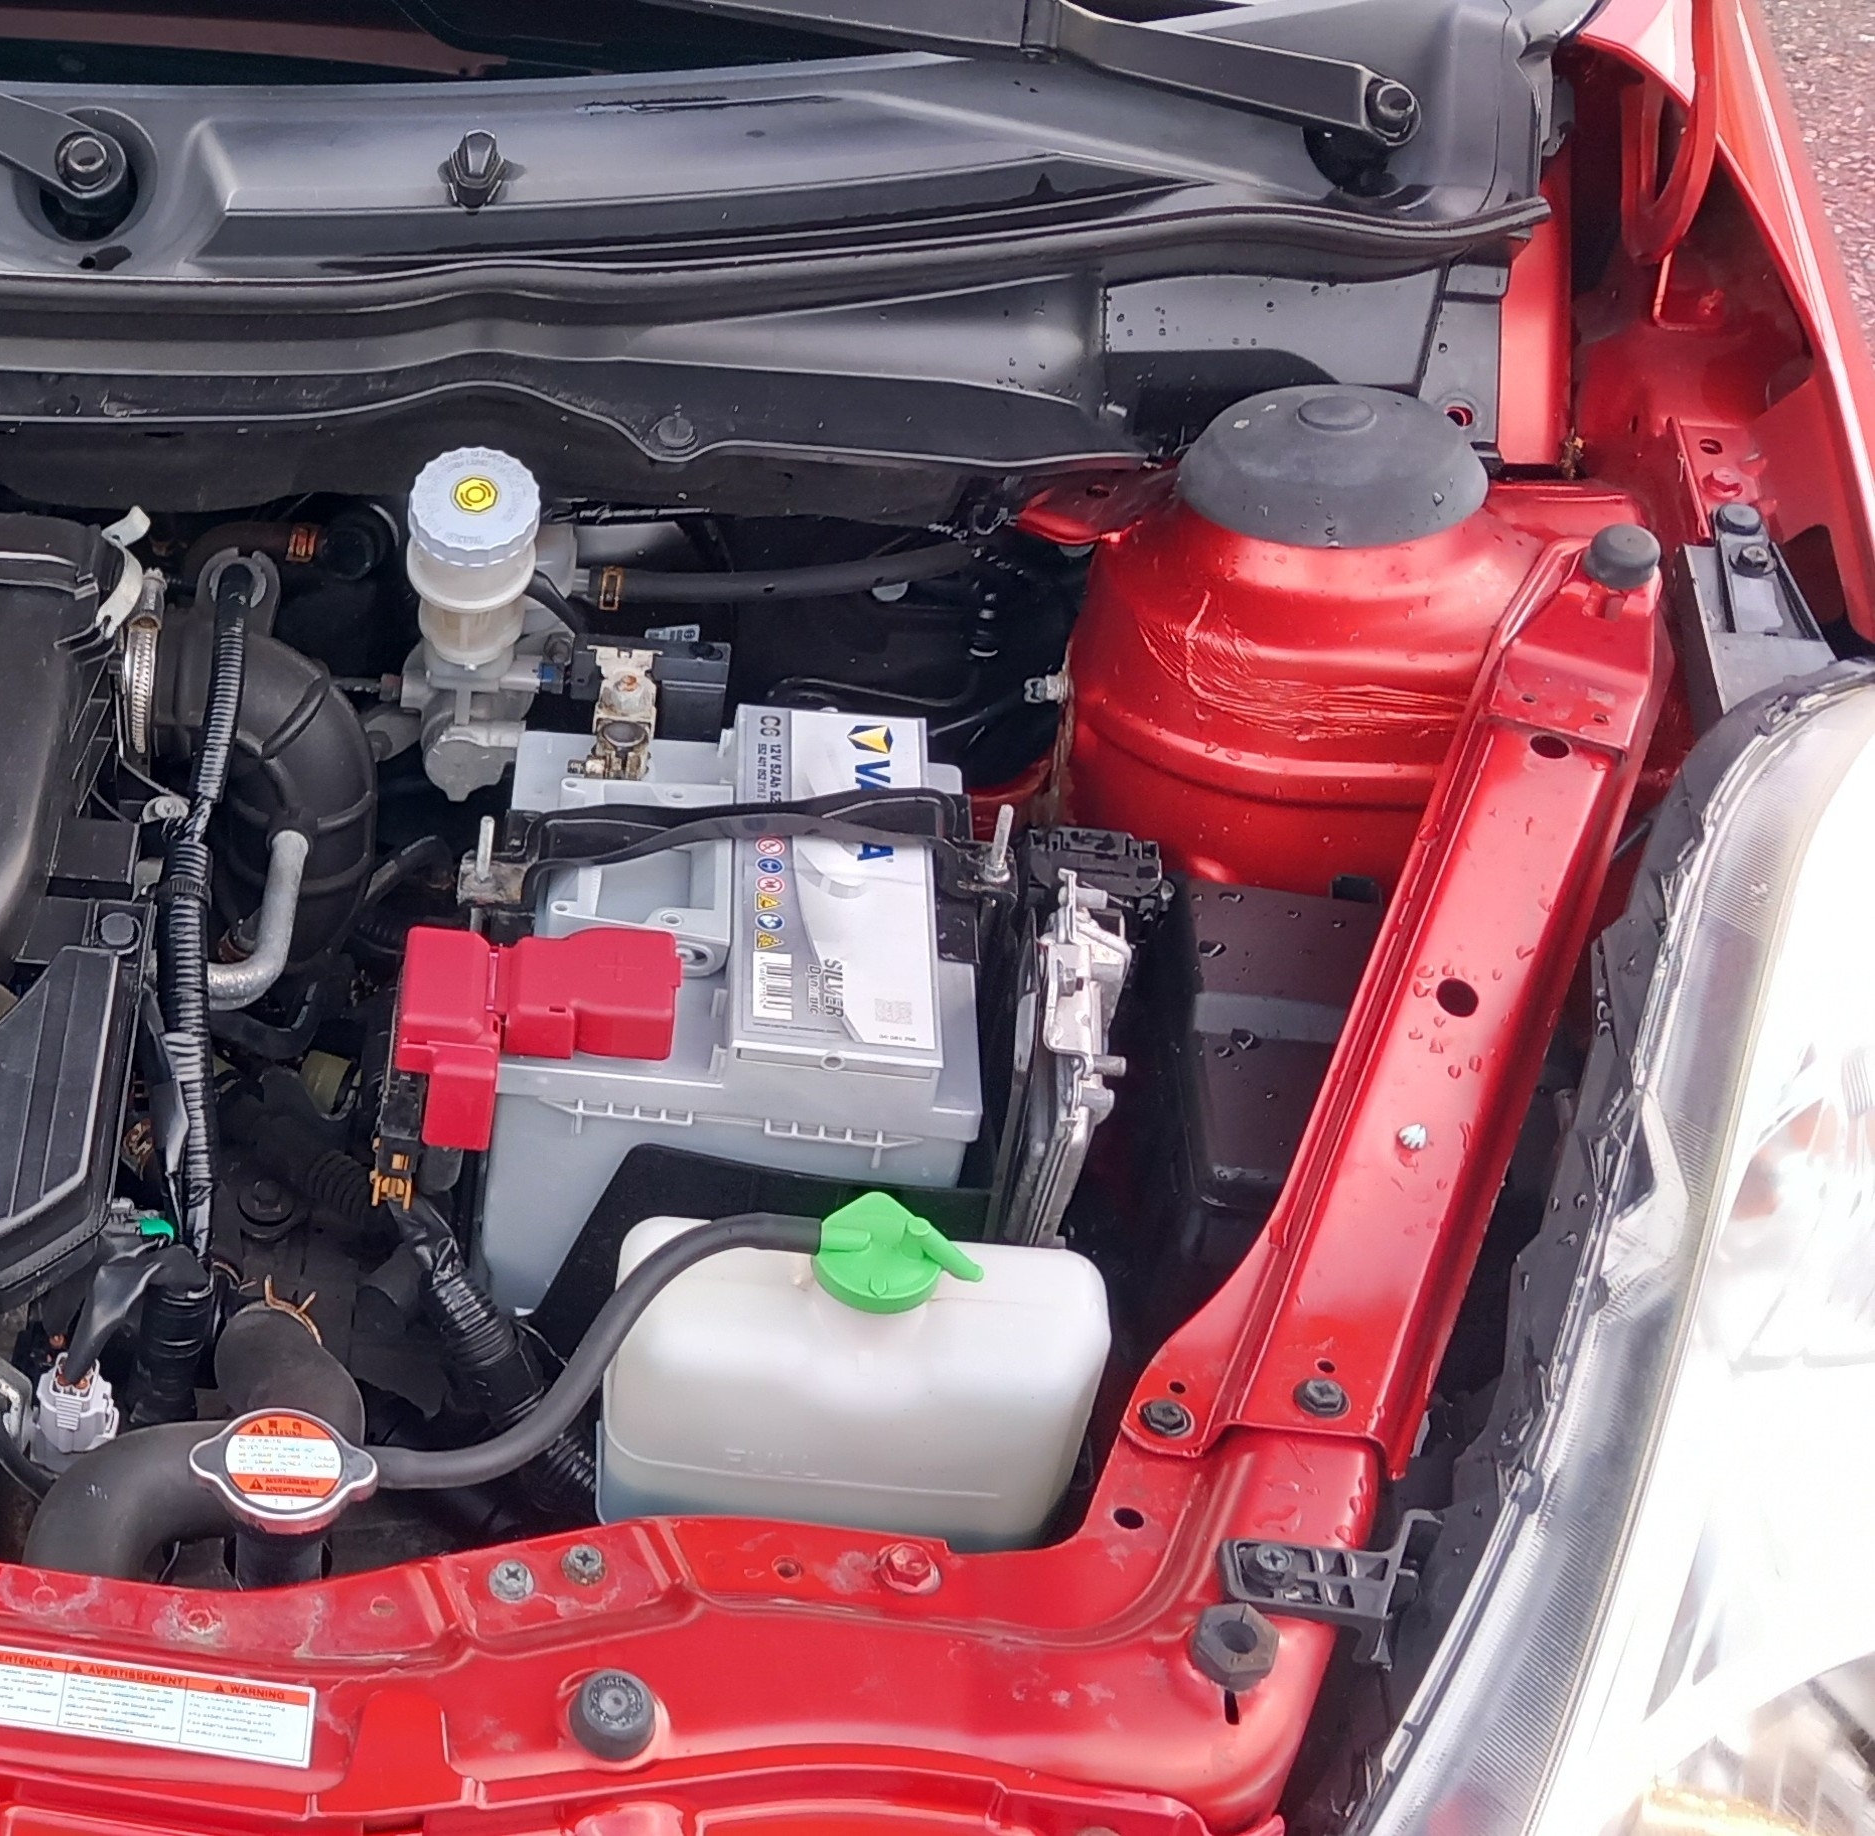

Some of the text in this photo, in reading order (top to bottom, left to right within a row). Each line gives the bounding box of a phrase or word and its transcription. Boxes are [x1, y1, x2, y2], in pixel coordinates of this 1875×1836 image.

[770, 744, 782, 804] 12V 52Ah 52
[807, 964, 823, 1015] Dynamic
[824, 958, 844, 1018] SILVER
[88, 1664, 184, 1686] AVERTISSEMENT
[230, 1685, 285, 1701] WARNING
